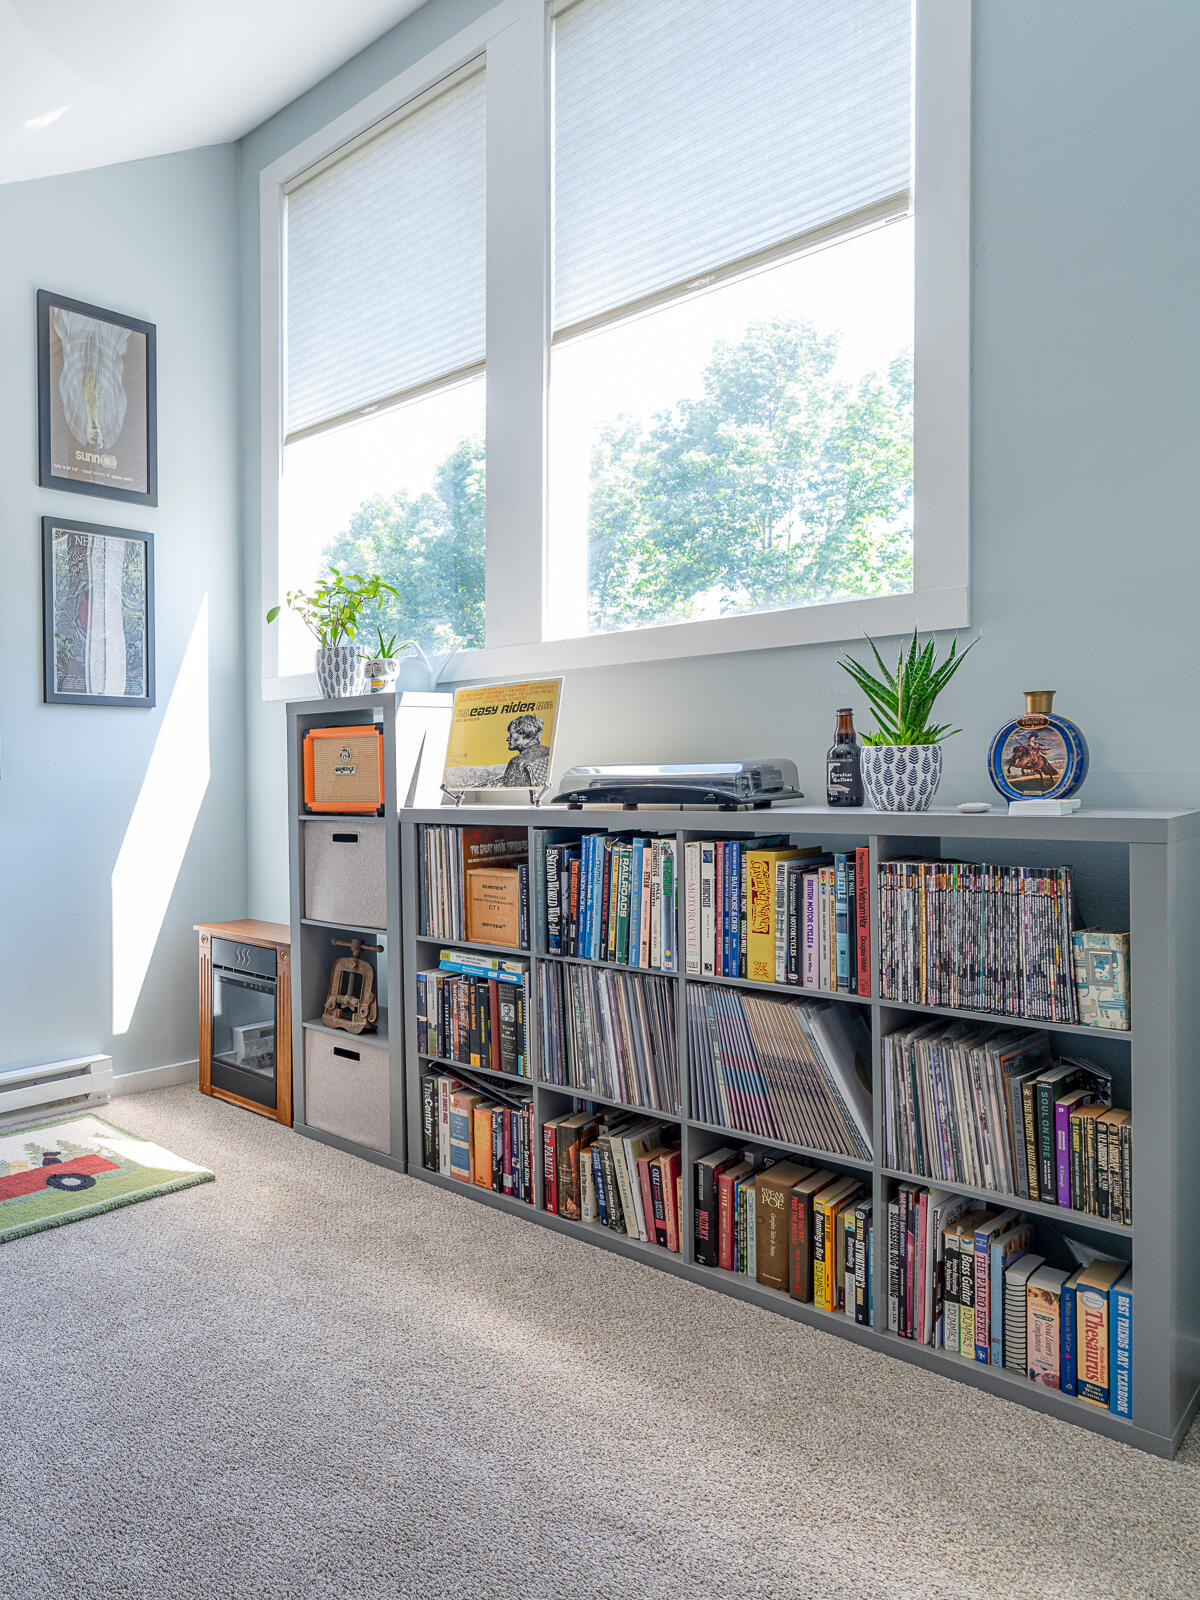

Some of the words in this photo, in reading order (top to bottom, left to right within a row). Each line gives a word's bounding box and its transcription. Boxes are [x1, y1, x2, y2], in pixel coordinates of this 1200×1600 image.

[469, 705, 498, 717] easy
[470, 844, 479, 855] THE
[547, 854, 559, 881] SECOND
[663, 858, 672, 896] TRAIN
[547, 881, 559, 906] WORLD
[620, 858, 630, 917] RAILROADS
[702, 878, 711, 908] MOTORCYCLES
[730, 876, 738, 911] BALTIMORE
[806, 879, 814, 900] BRITISH
[837, 872, 846, 899] BEETLE
[806, 901, 814, 923] MOTOR
[859, 887, 867, 915] Vietnam
[548, 907, 560, 923] WAR
[688, 883, 696, 950] MOTORCYCLE
[806, 924, 814, 944] CYCLES
[424, 1099, 434, 1136] Century
[1024, 1099, 1032, 1112] THE
[1040, 1091, 1049, 1117] SOUL
[1024, 1113, 1034, 1142] PROPHET
[1041, 1119, 1049, 1134] ON
[1027, 1144, 1035, 1165] KAHLIL
[1042, 1136, 1050, 1158] FIRE
[1098, 1143, 1108, 1170] LOVECRAFT
[1109, 1144, 1119, 1172] LOVECRAFT
[544, 1144, 554, 1182] FAMILY
[652, 1168, 660, 1185] OIL!
[620, 1180, 629, 1209] CLASSICS
[762, 1194, 785, 1210] POE
[769, 1213, 777, 1230] Complete
[814, 1213, 823, 1241] Running
[890, 1212, 899, 1251] SUCCESSFUL
[816, 1246, 824, 1260] Bar
[855, 1240, 865, 1288] SKYWATCHER'S
[890, 1252, 899, 1266] DOG
[961, 1254, 972, 1275] Bass
[977, 1254, 986, 1274] THE
[815, 1266, 824, 1298] DUMMIES
[890, 1267, 899, 1298] TRAINING
[961, 1276, 972, 1305] Guitar
[977, 1277, 986, 1306] PALEO
[1118, 1295, 1129, 1314] BEST
[947, 1308, 957, 1343] DUMMIES
[963, 1311, 973, 1348] DUMMIES
[977, 1309, 987, 1346] EFFECT
[1032, 1319, 1042, 1353] Companion
[1046, 1322, 1054, 1338] Food
[1117, 1316, 1129, 1348] FRIENDS
[1046, 1339, 1054, 1357] Lover's
[1085, 1310, 1104, 1383] Thesaurus
[1117, 1350, 1129, 1366] DAY
[1098, 1345, 1106, 1384] Merriam-Webster's
[1117, 1369, 1129, 1414] YEARBOOK
